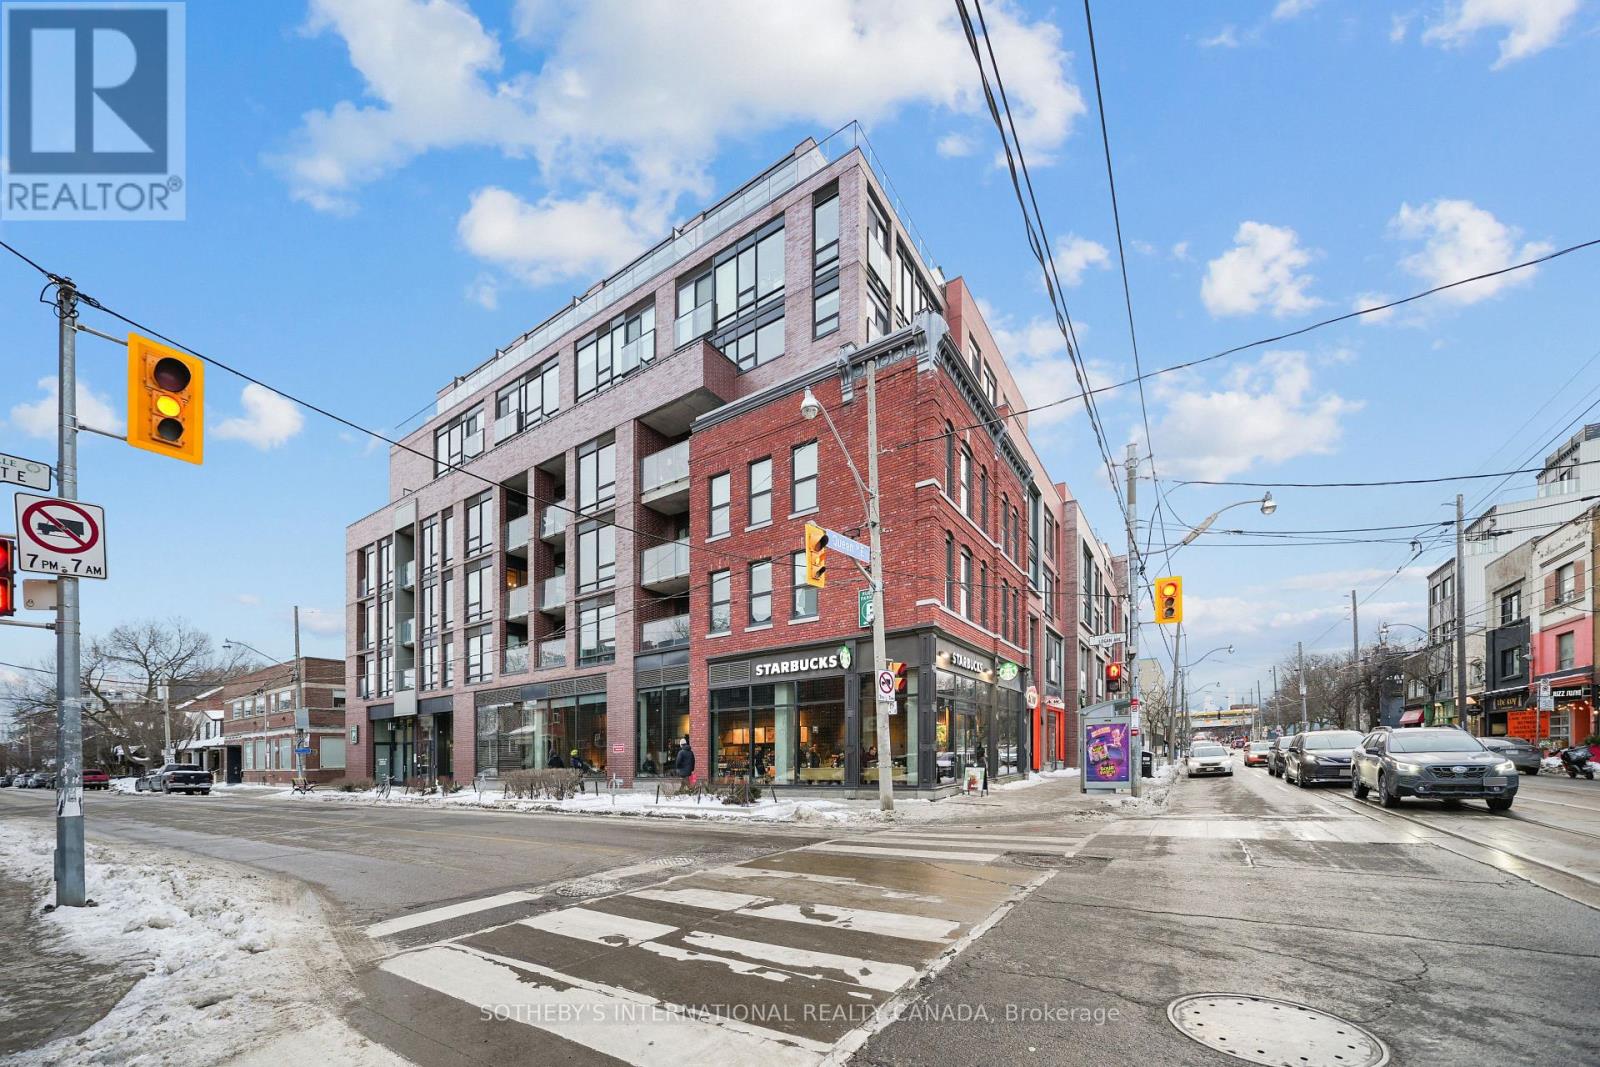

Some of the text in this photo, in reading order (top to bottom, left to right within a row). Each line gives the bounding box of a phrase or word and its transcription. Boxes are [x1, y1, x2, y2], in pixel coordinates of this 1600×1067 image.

[0, 457, 17, 468] LE
[17, 470, 27, 483] E
[26, 553, 39, 568] 7
[41, 560, 59, 570] PM
[71, 558, 82, 573] 7
[85, 565, 103, 575] AM
[755, 654, 838, 676] STARBUCKS
[952, 652, 984, 673] STARBUCKS
